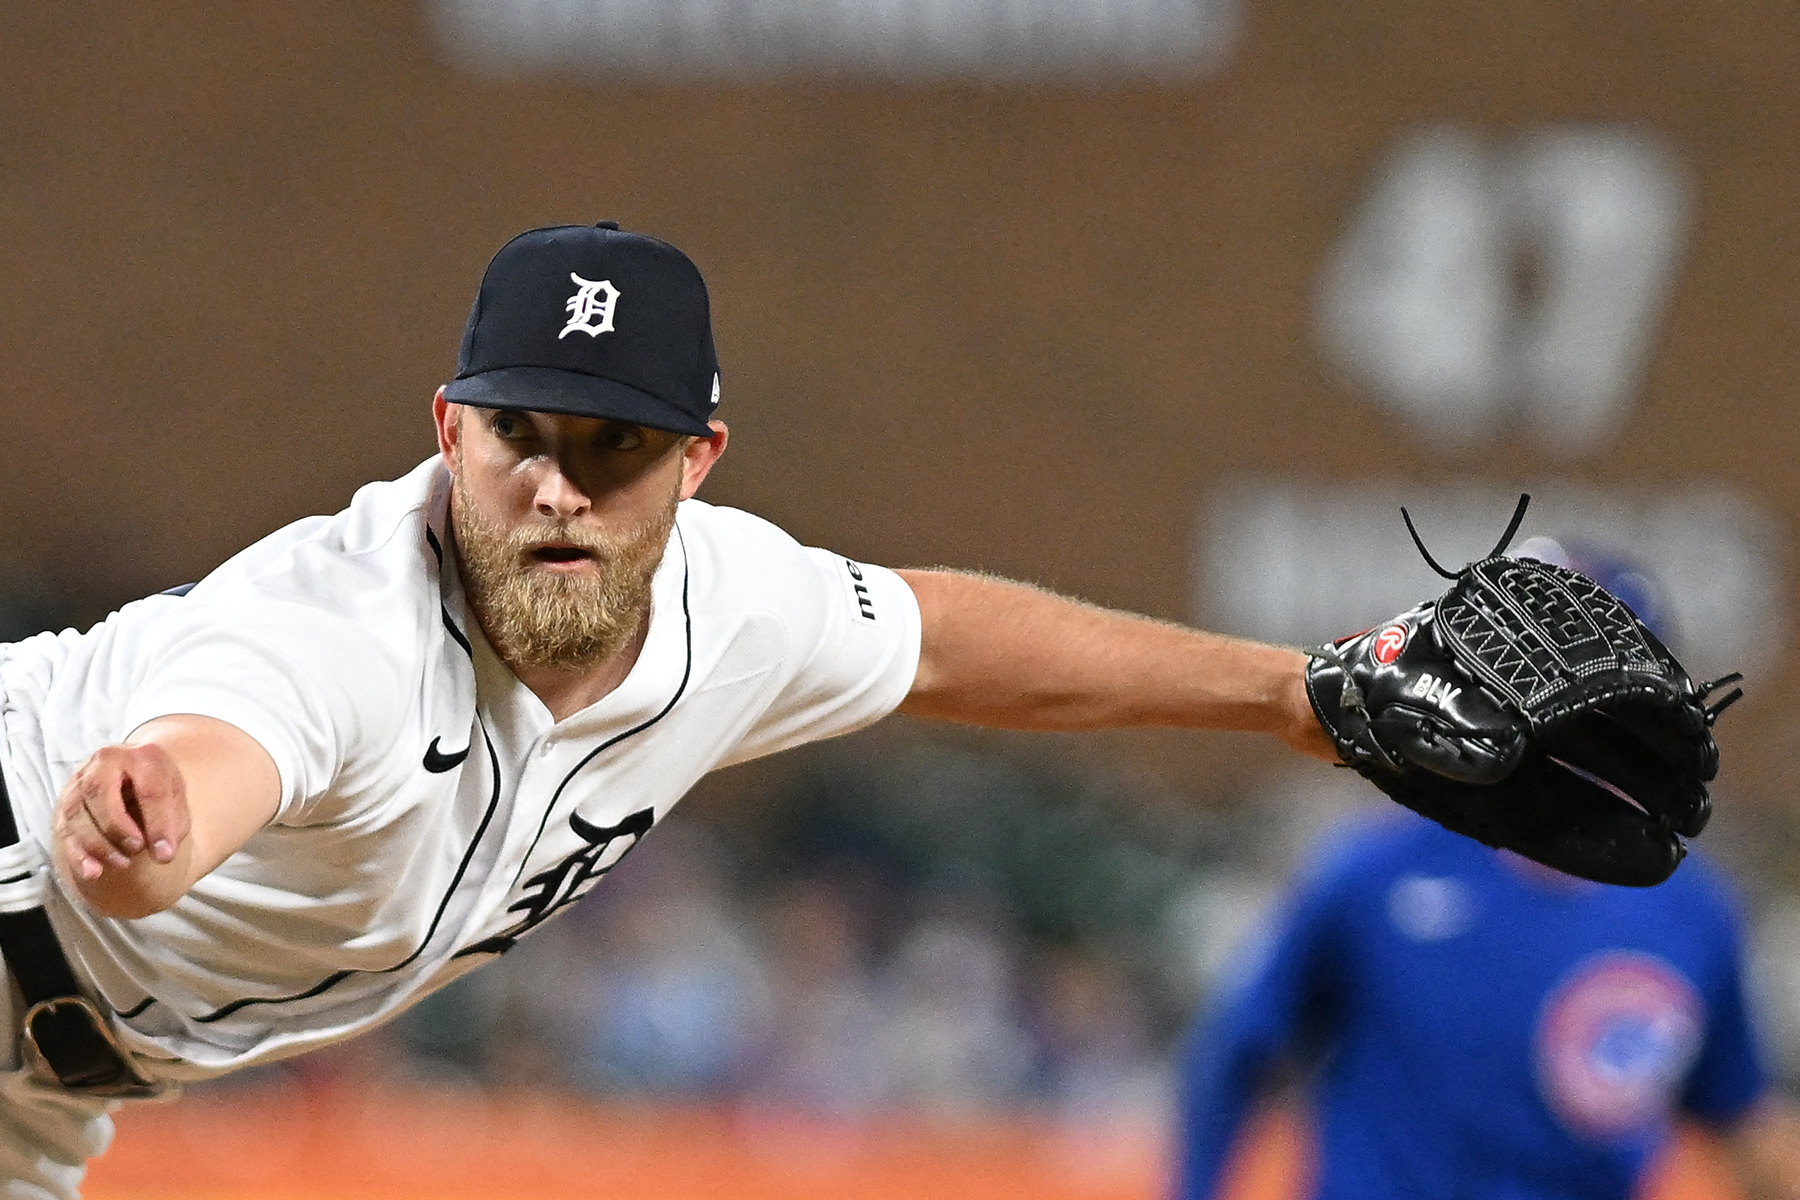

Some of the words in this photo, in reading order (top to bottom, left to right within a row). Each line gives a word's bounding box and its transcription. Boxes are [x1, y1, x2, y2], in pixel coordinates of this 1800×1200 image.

[558, 272, 621, 339] D
[1318, 124, 1692, 450] 47
[1412, 673, 1462, 709] BLV
